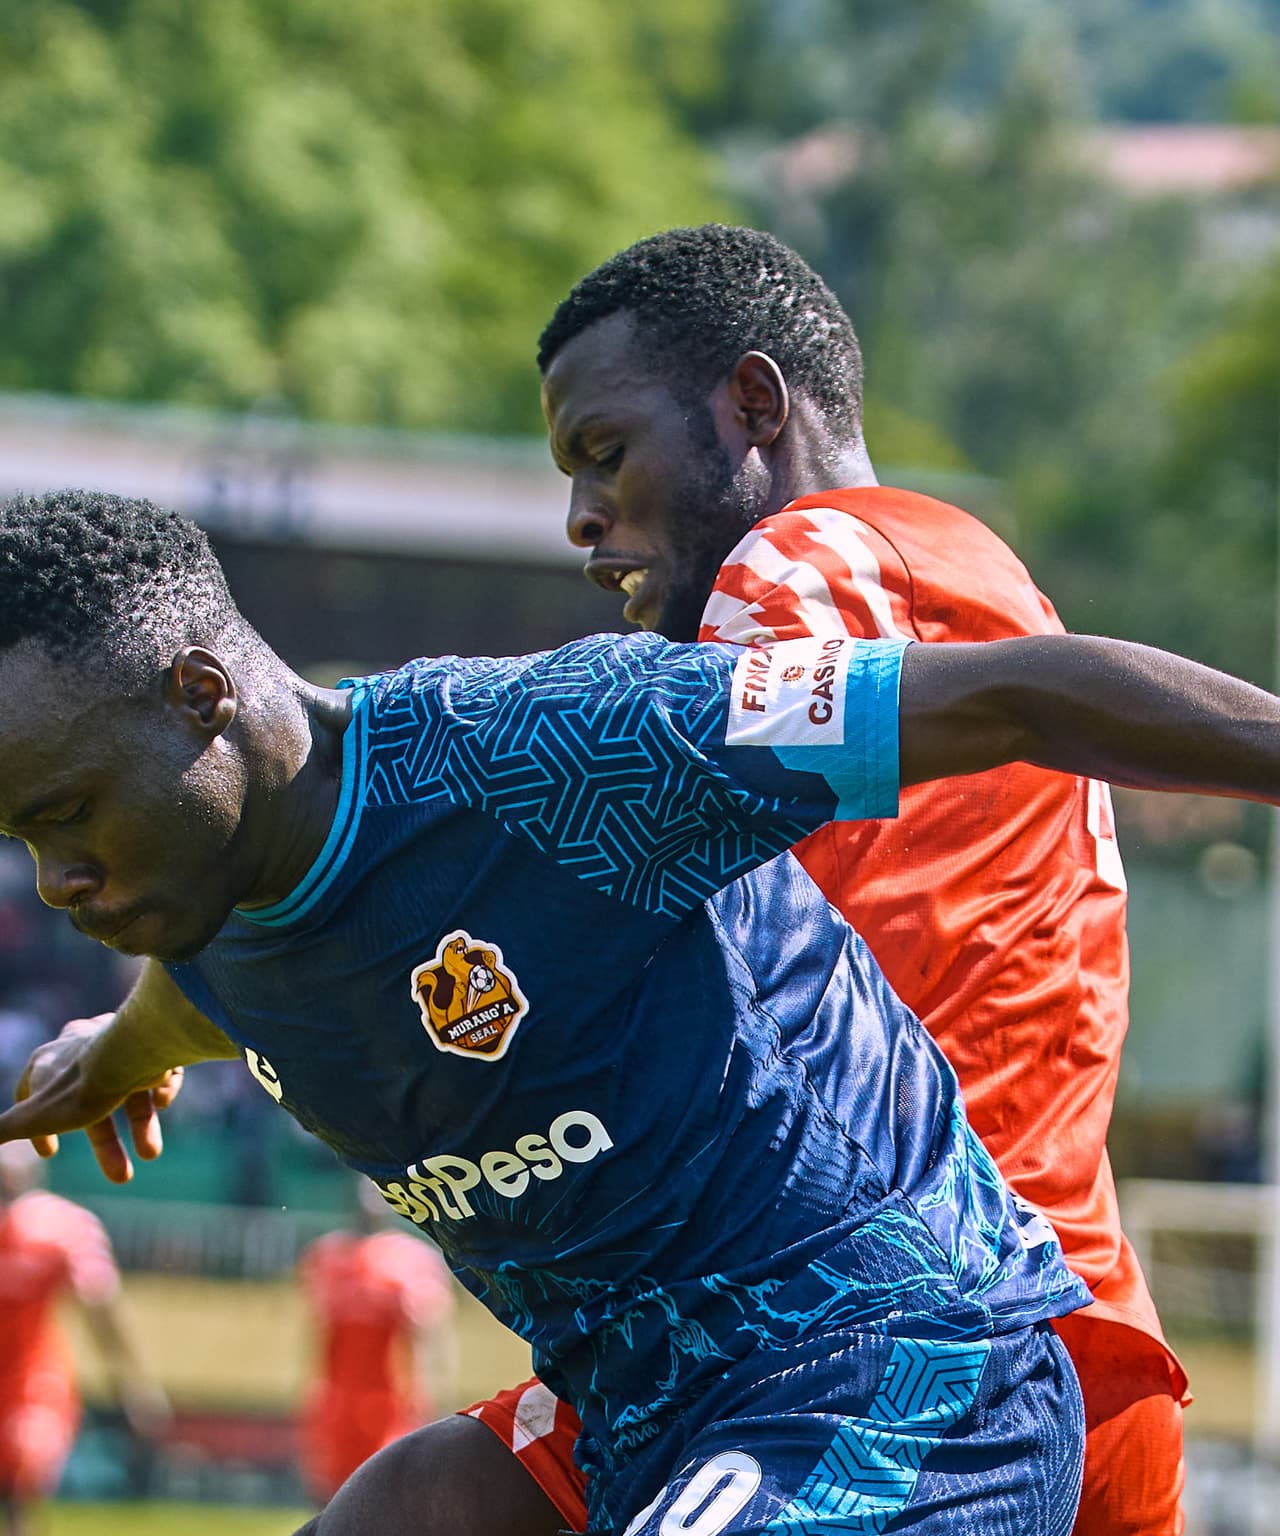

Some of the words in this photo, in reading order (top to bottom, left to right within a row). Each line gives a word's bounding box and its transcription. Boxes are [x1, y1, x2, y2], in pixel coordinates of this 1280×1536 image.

[808, 640, 844, 725] CASINO
[448, 1003, 515, 1041] MURANG'A
[470, 1025, 498, 1044] SEAL
[372, 1110, 614, 1224] ortPesa
